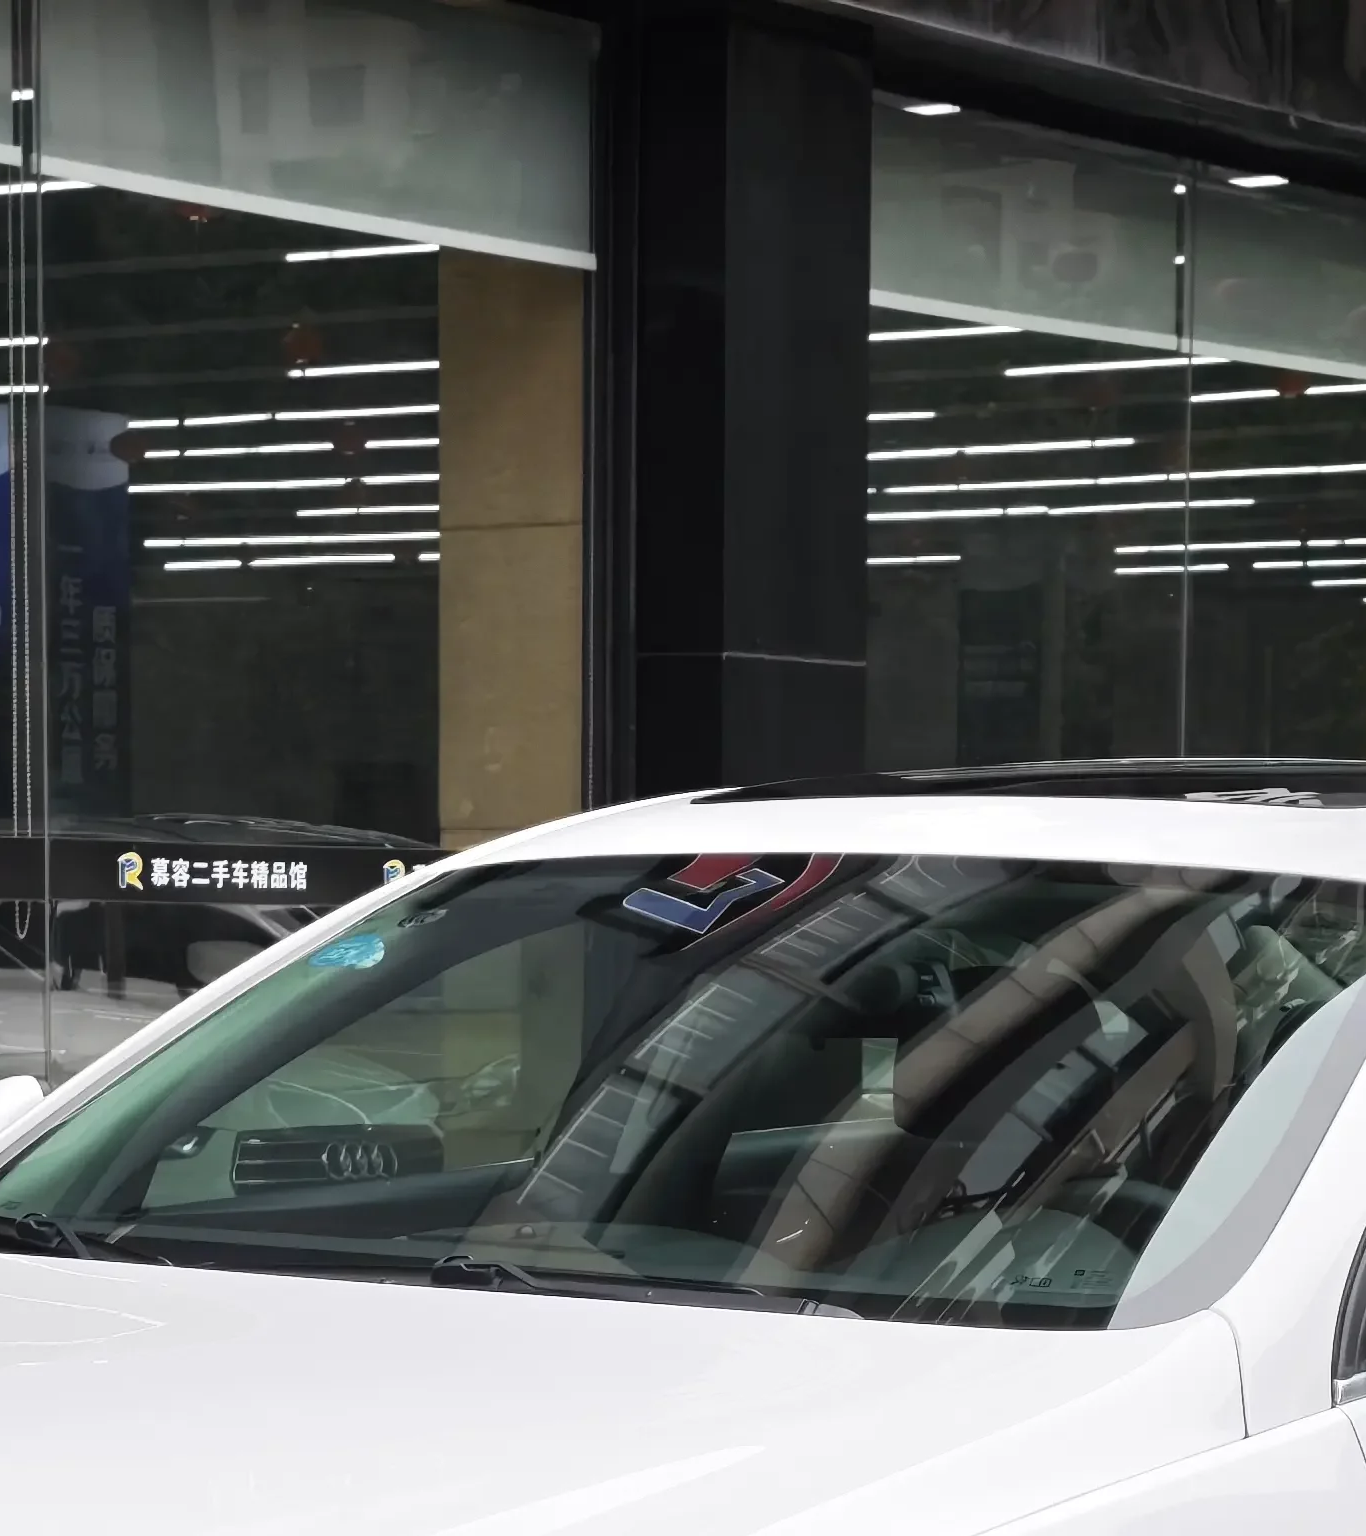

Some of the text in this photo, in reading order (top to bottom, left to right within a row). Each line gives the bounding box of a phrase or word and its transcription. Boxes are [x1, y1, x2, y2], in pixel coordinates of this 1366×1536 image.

[150, 857, 309, 891] 慕容二手车精品馆
